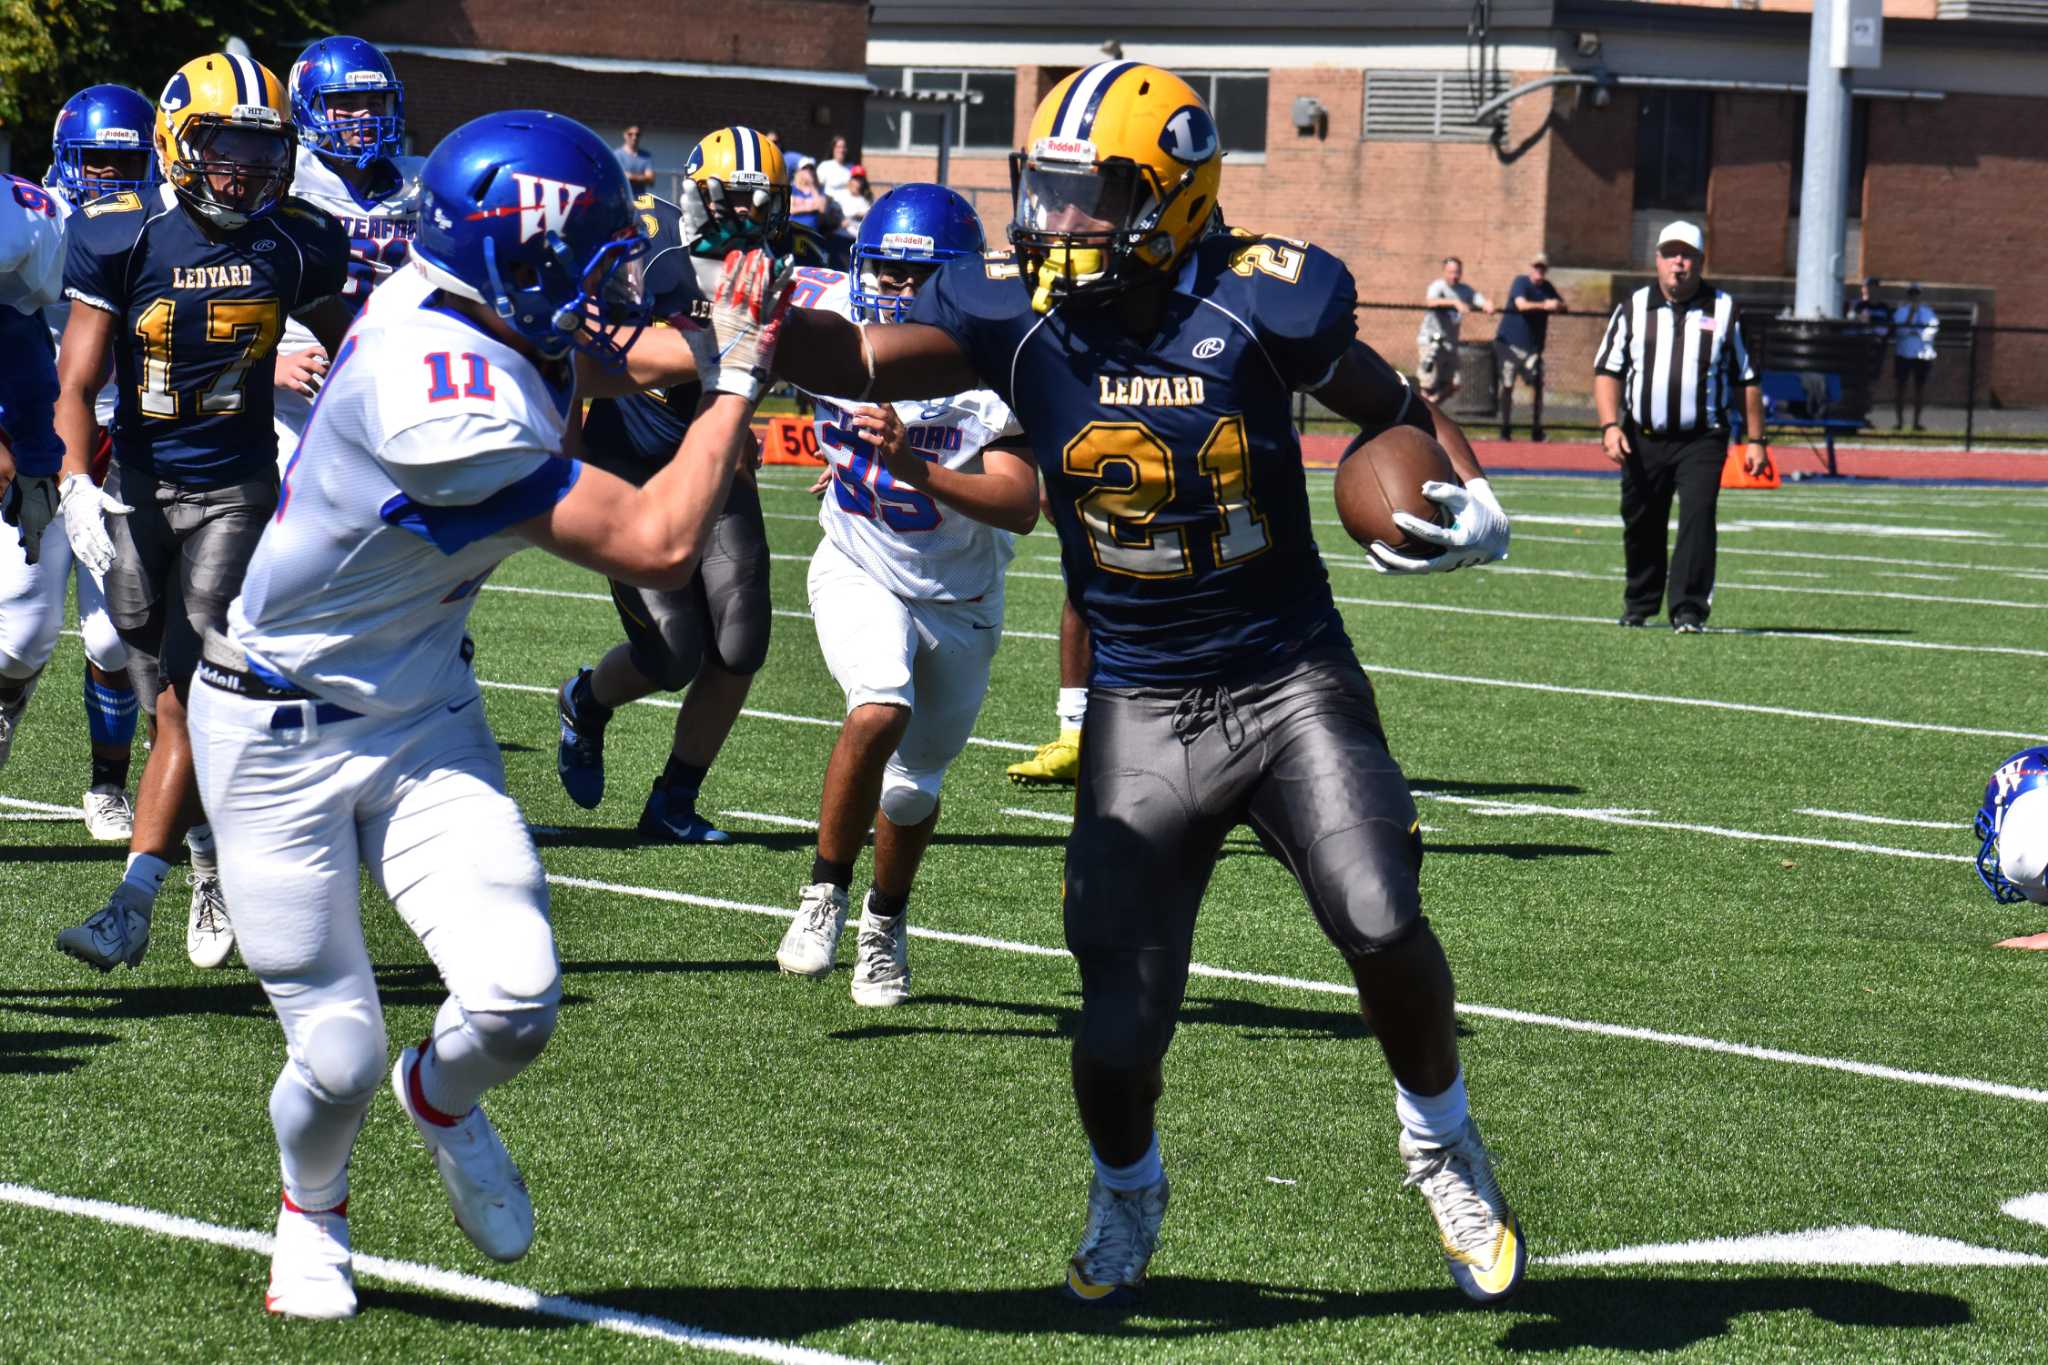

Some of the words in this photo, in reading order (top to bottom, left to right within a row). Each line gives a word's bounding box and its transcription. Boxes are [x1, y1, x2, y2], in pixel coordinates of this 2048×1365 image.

[1047, 140, 1082, 154] Riddell
[172, 263, 253, 289] LEDYARD
[135, 298, 280, 420] 17
[423, 351, 496, 403] 11
[1099, 375, 1205, 407] LEDYARD
[782, 424, 820, 458] 50
[822, 421, 943, 532] 35
[1062, 415, 1273, 580] 21
